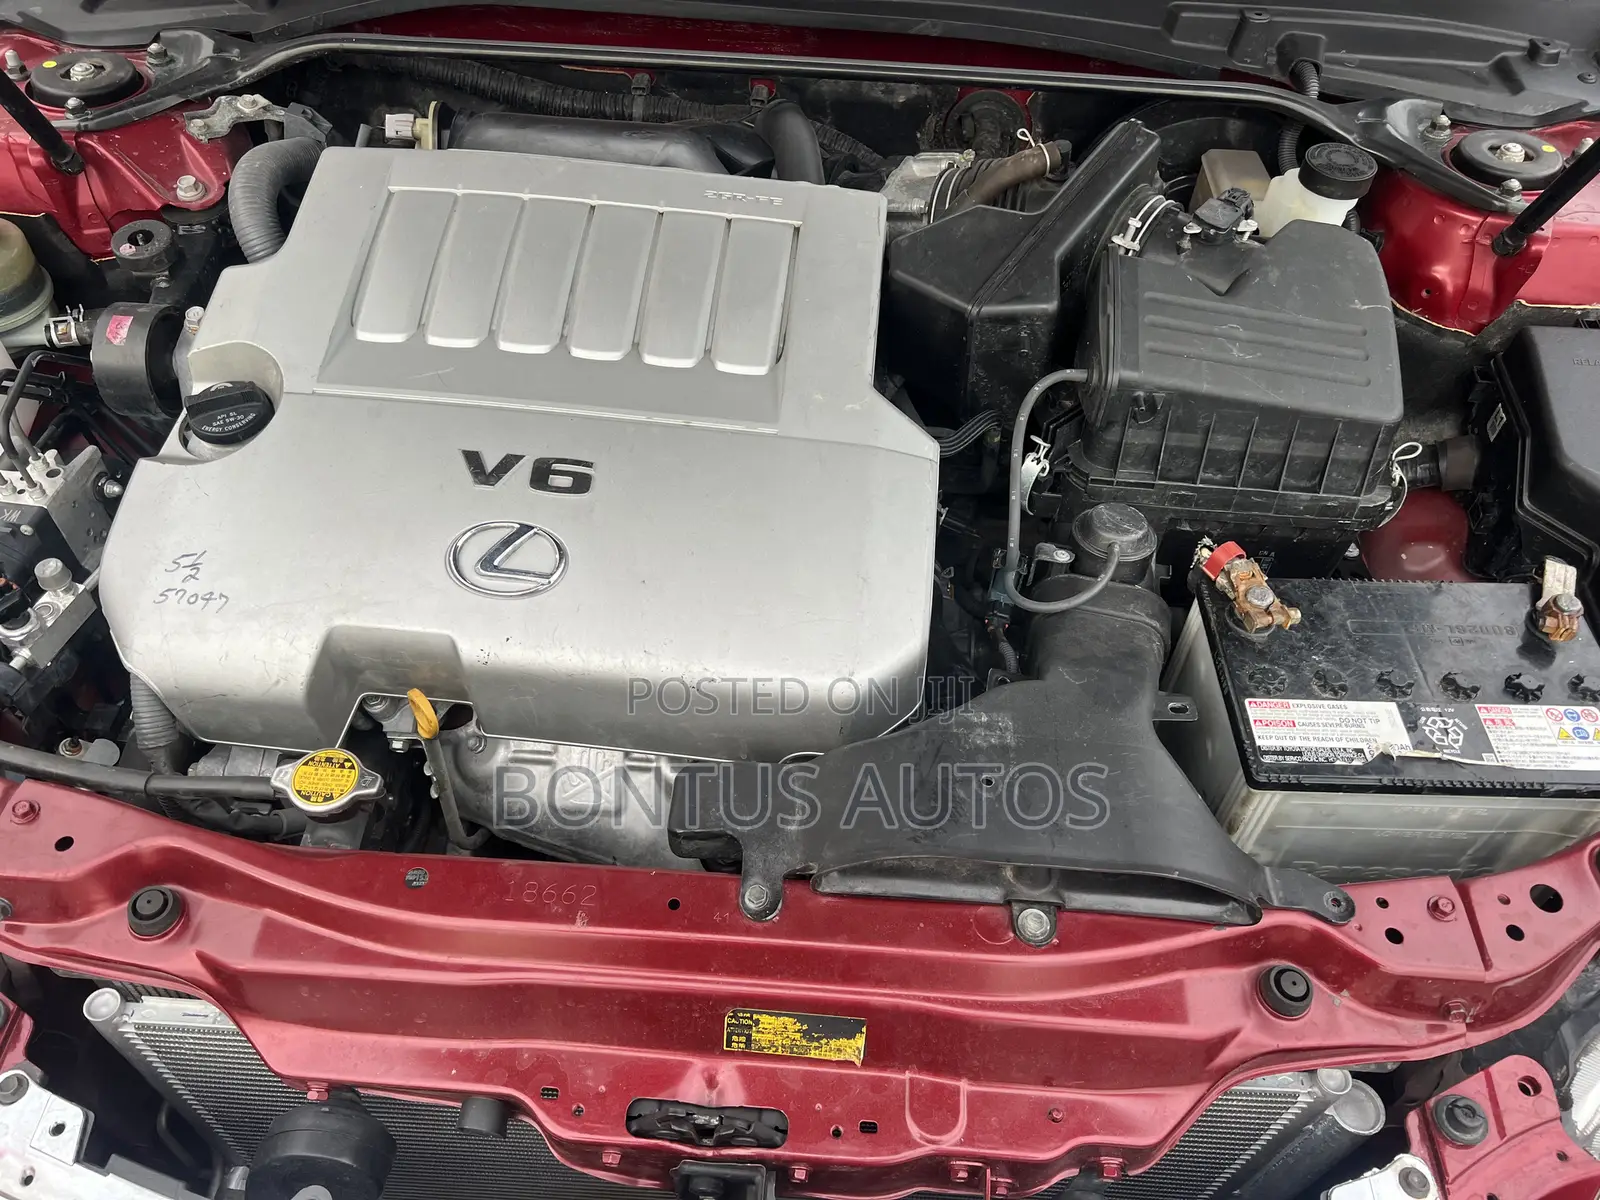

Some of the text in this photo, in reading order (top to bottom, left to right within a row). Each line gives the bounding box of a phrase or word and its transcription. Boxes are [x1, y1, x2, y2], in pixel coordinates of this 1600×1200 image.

[224, 413, 256, 431] CONSERVING
[226, 415, 244, 423] 5W-30
[457, 448, 596, 498] V6
[152, 587, 230, 614] 57047
[1257, 701, 1291, 709] DANGER
[1262, 719, 1294, 728] POISON
[1345, 736, 1378, 744] CHILDREN
[504, 880, 598, 906] 18662
